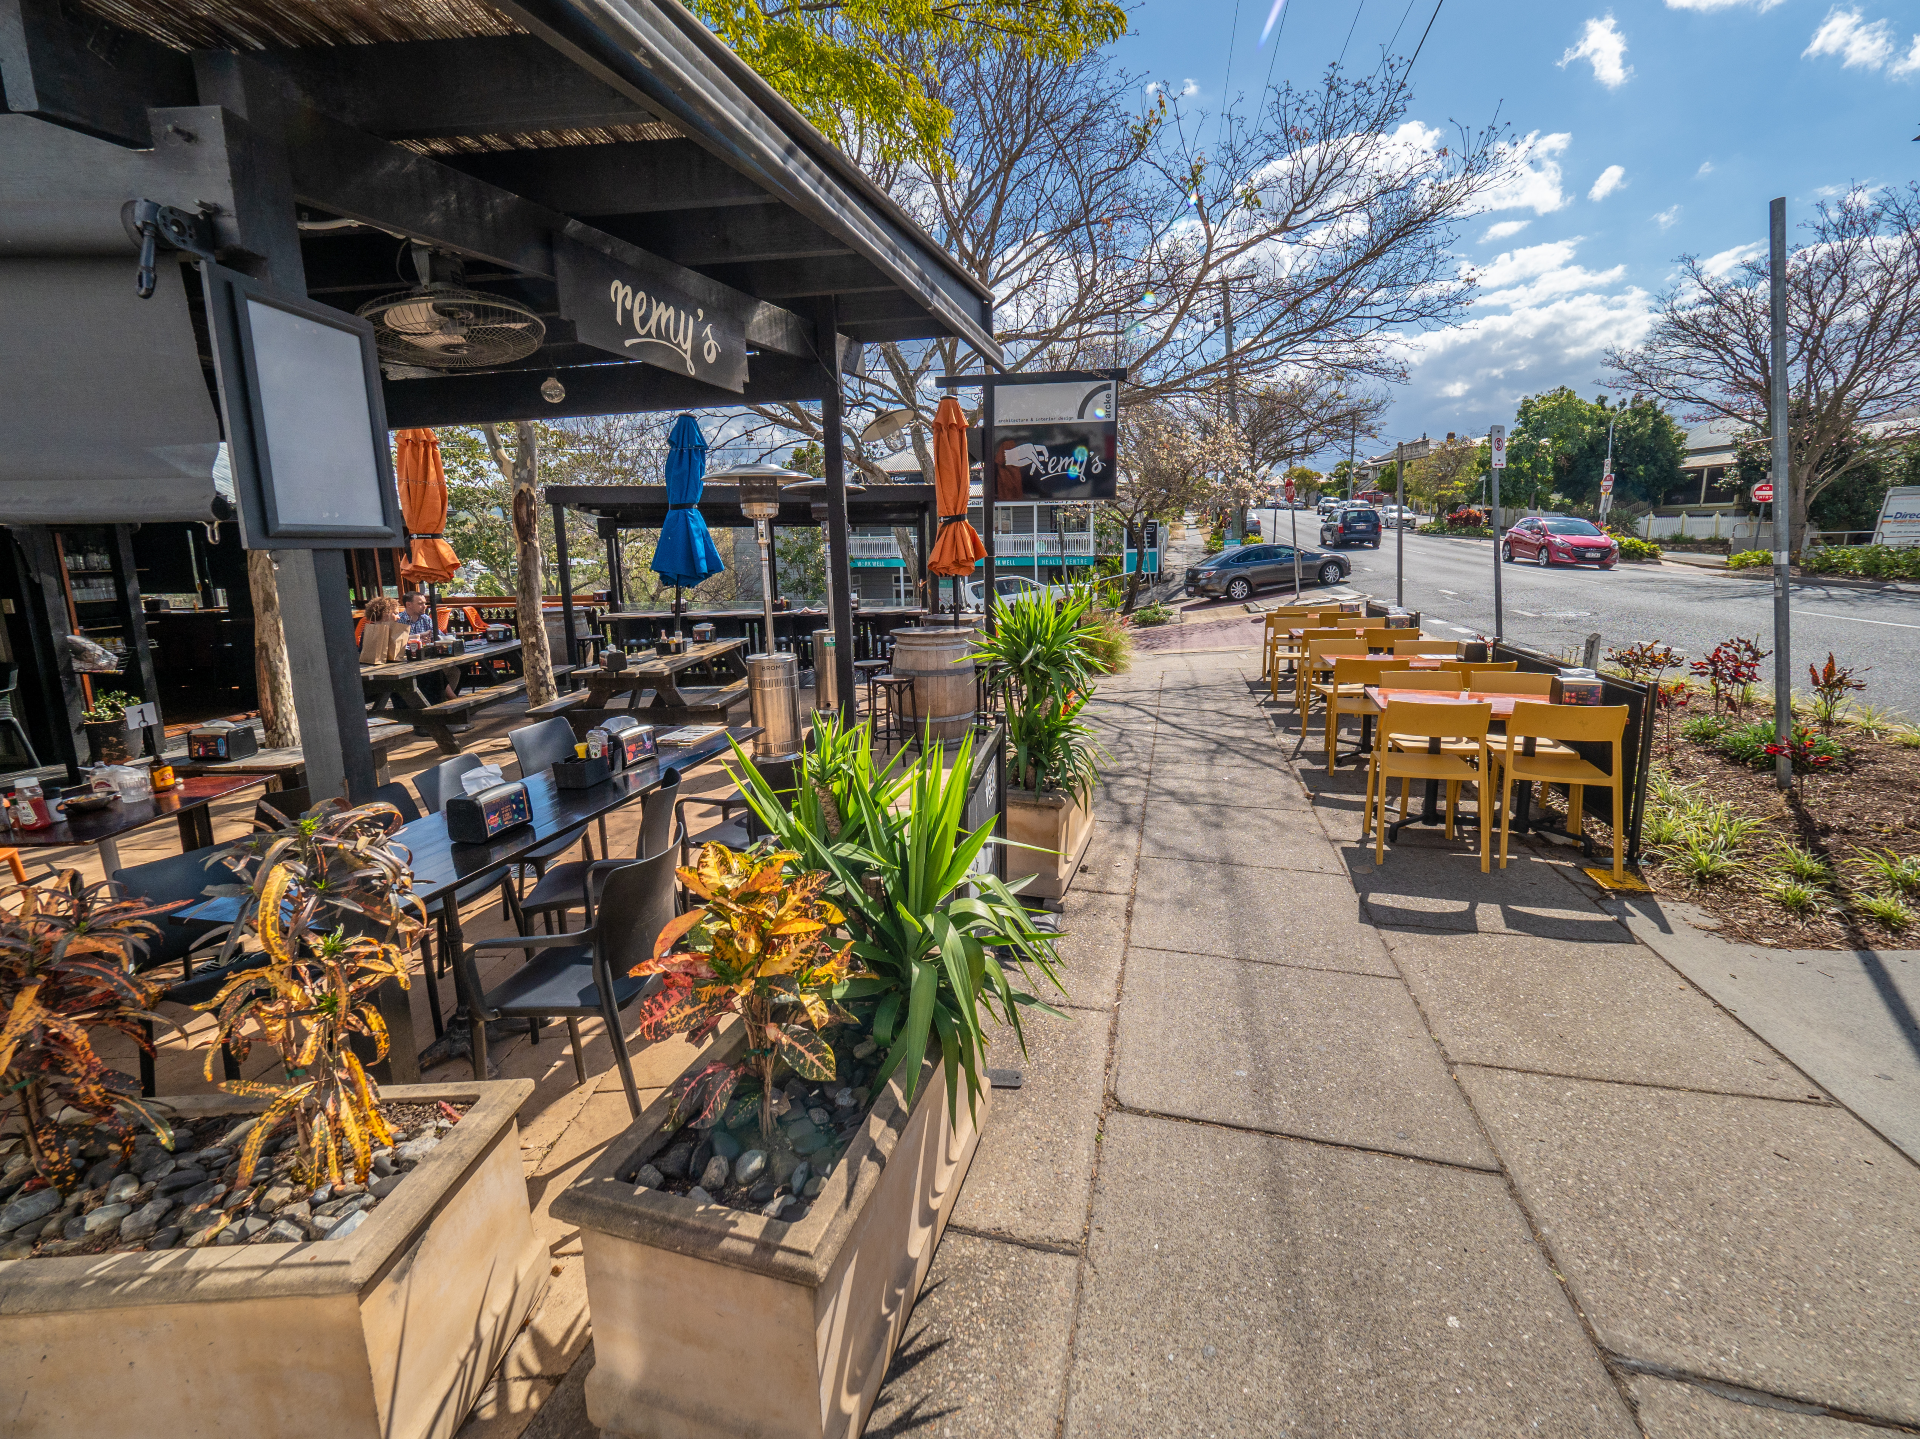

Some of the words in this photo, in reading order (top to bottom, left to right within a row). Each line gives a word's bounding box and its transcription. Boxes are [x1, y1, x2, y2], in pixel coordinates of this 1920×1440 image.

[1103, 393, 1112, 419] arcke
[761, 663, 788, 672] BROMIC
[137, 707, 146, 723] 1
